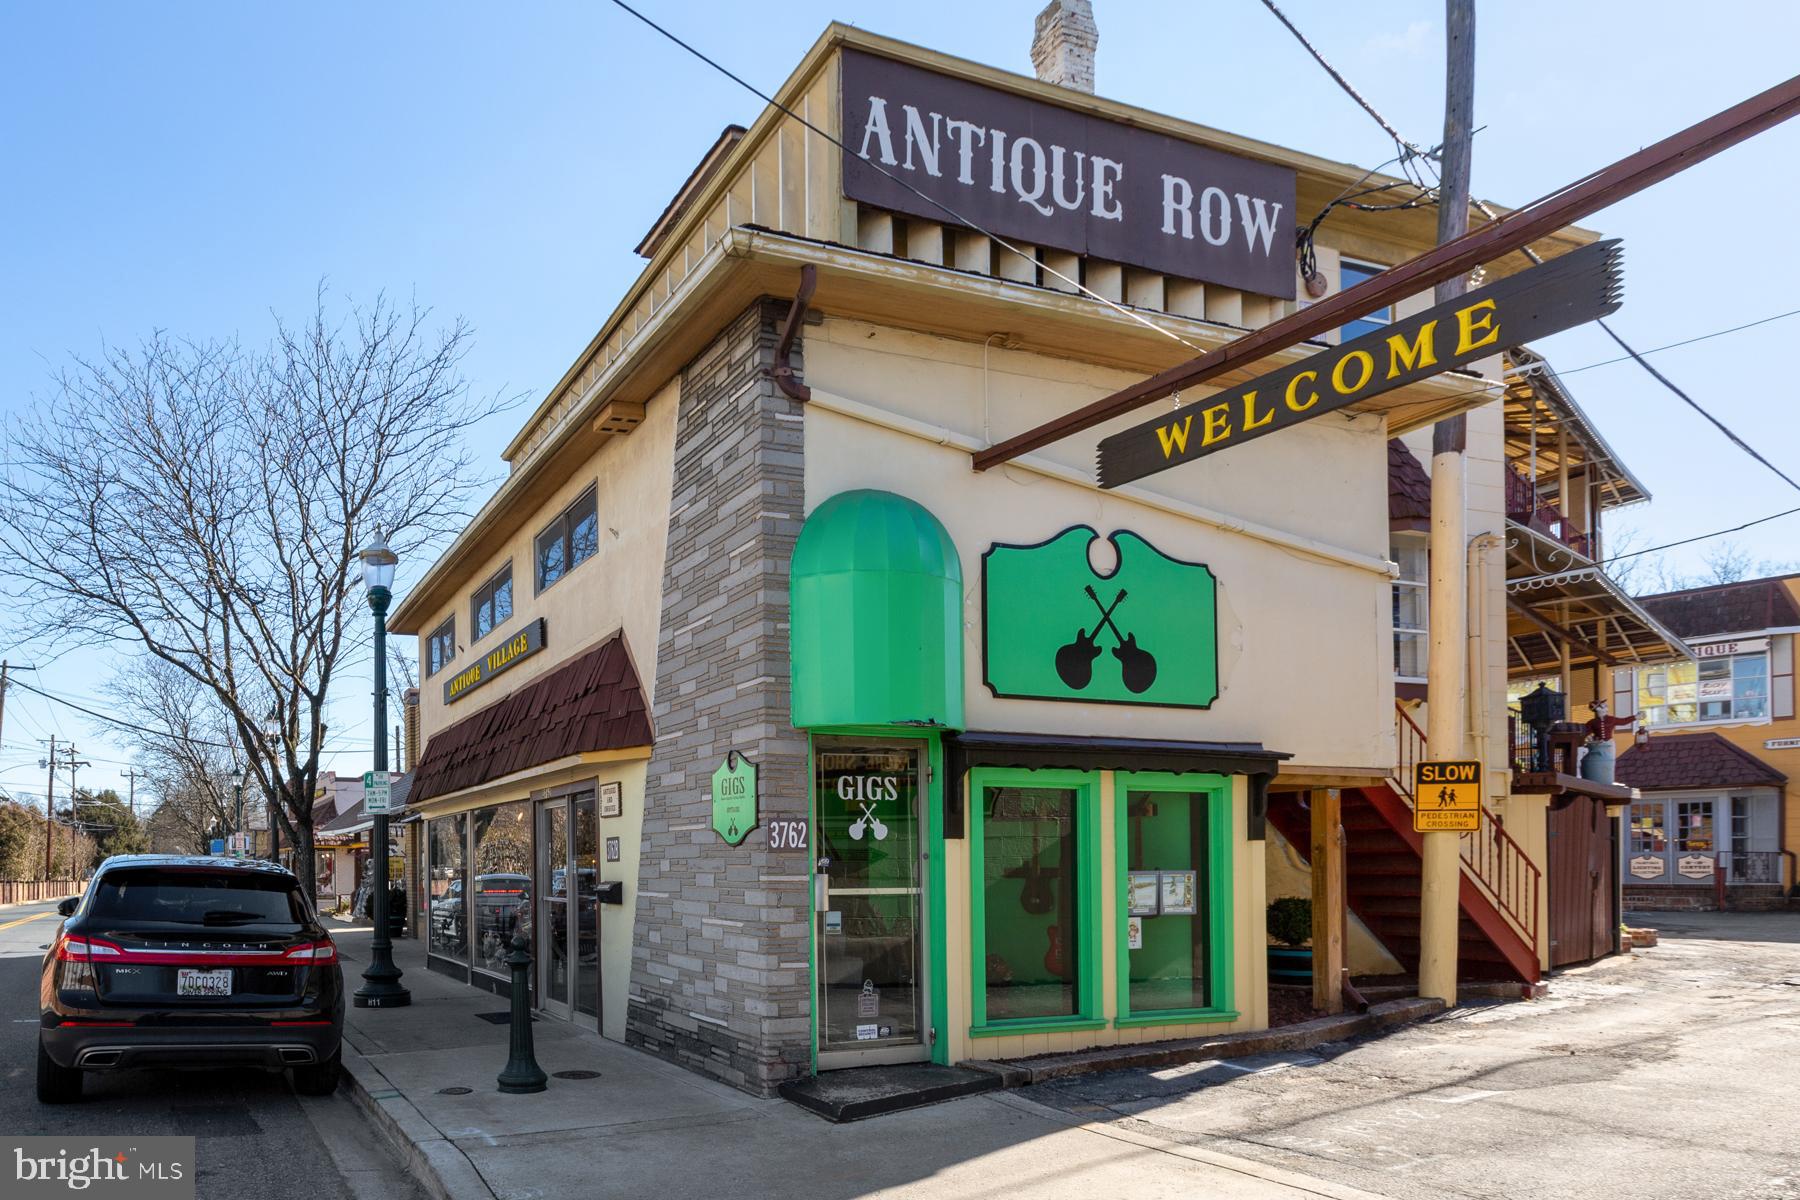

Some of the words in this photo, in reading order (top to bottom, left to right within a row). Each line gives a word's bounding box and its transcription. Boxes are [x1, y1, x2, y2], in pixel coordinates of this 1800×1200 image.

[857, 95, 1123, 222] ANTIQUE
[1160, 173, 1283, 257] ROW
[1155, 298, 1501, 460] WELCOME
[449, 664, 481, 697] ANTIQUE
[487, 633, 528, 672] VILLAGE
[366, 775, 372, 786] 4
[1422, 765, 1475, 781] SLOW
[721, 776, 745, 796] GIGS
[837, 775, 898, 800] GIGS
[770, 821, 807, 848] 3762
[1426, 820, 1469, 828] CROSSING
[144, 941, 267, 949] LINCOLN
